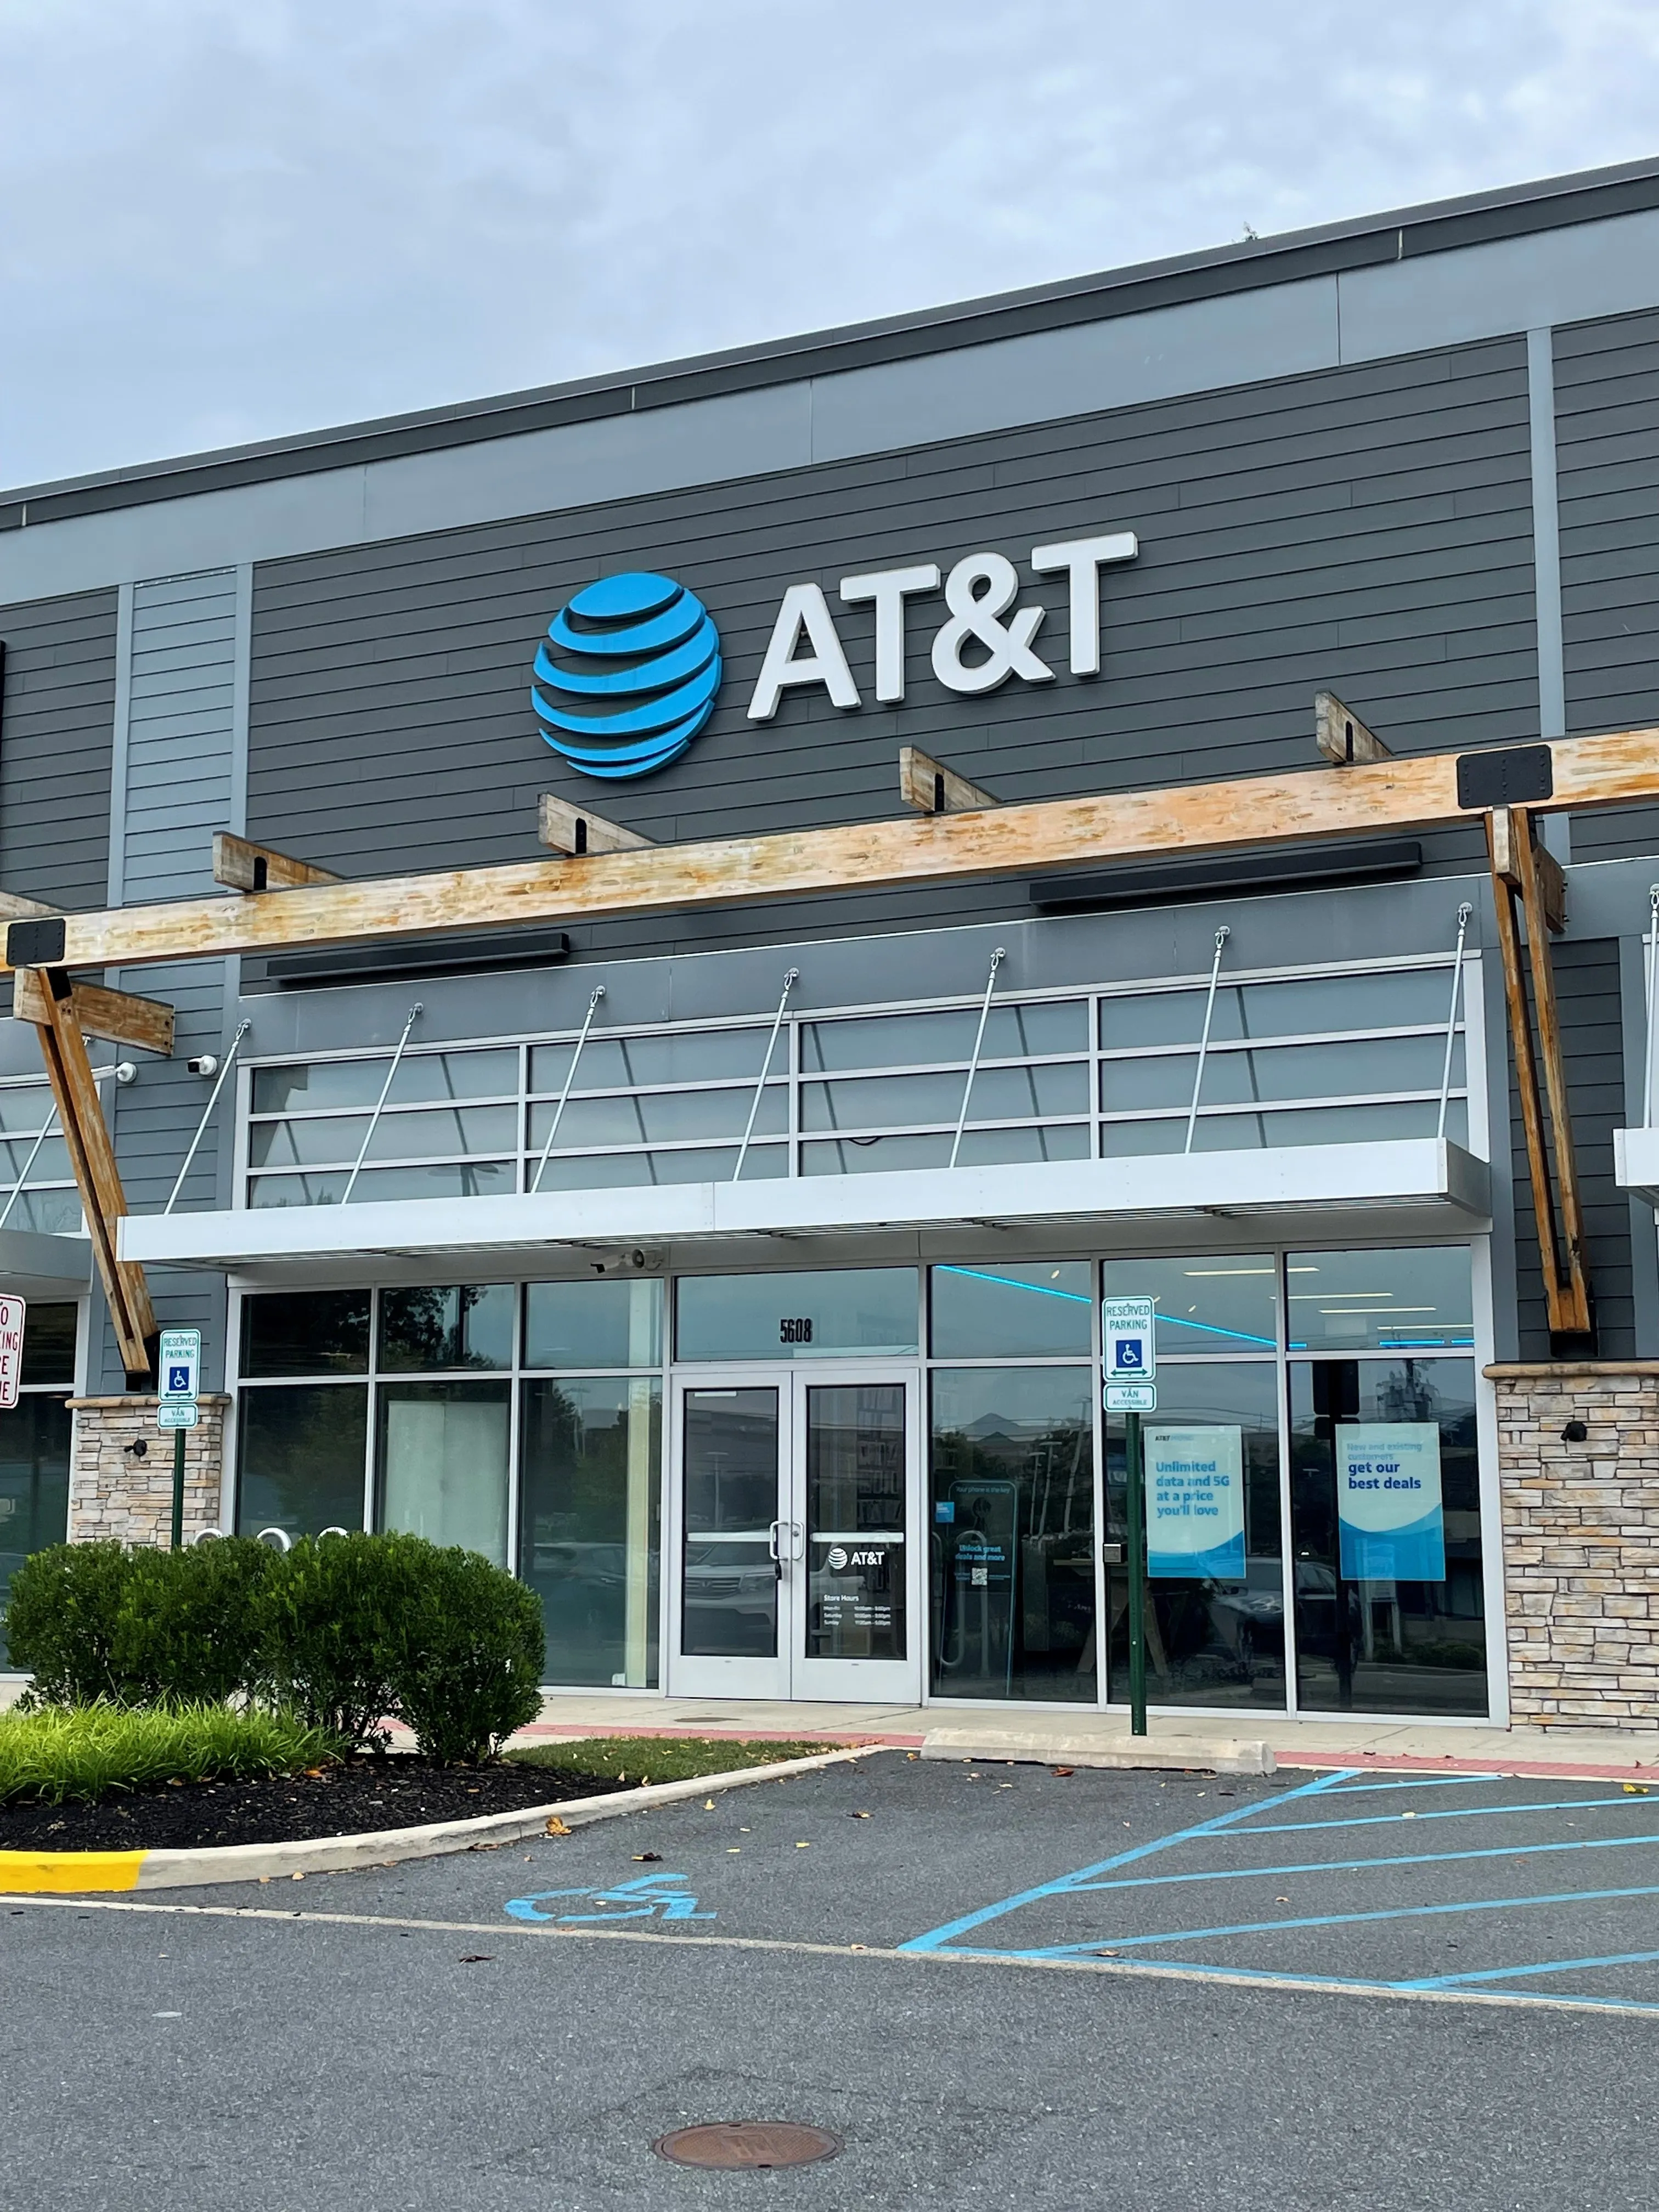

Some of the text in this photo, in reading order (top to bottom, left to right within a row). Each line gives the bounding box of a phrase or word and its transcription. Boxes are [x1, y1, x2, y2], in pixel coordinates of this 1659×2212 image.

[747, 531, 1138, 721] AT&T
[0, 1307, 8, 1325] O
[1107, 1305, 1149, 1316] RESERVED
[780, 1318, 812, 1343] 5608
[1110, 1319, 1147, 1330] PARKING
[163, 1337, 197, 1346] RESERVED
[166, 1350, 194, 1358] PARKING
[1387, 1442, 1423, 1452] existing
[1156, 1460, 1216, 1472] Unlimited
[1348, 1462, 1400, 1476] get our
[1156, 1475, 1229, 1486] data and 5G
[1348, 1477, 1421, 1489] best deals
[1156, 1490, 1214, 1504] at a price
[1157, 1504, 1218, 1519] you'll love
[851, 1551, 885, 1565] AT&T
